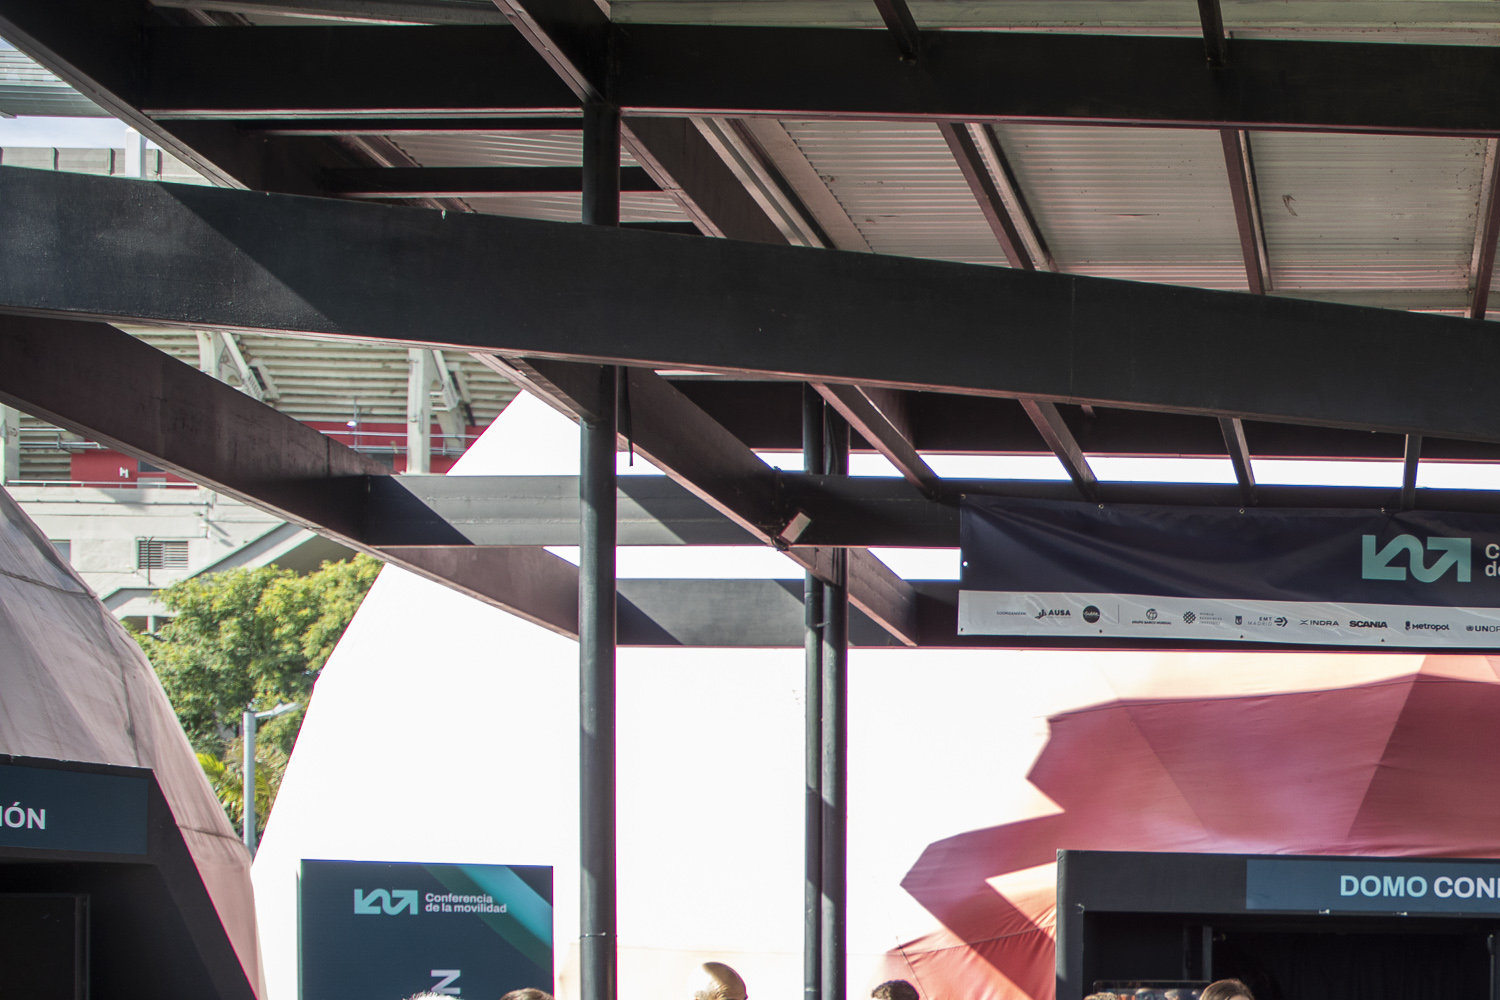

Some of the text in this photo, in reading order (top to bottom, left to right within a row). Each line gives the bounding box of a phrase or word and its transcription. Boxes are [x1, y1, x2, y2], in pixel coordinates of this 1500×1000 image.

[1349, 620, 1388, 628] SCANIA
[1412, 623, 1450, 632] Metropol
[1340, 875, 1428, 898] DOMO
[424, 892, 493, 904] Conferencia
[424, 903, 507, 914] de la movilidad
